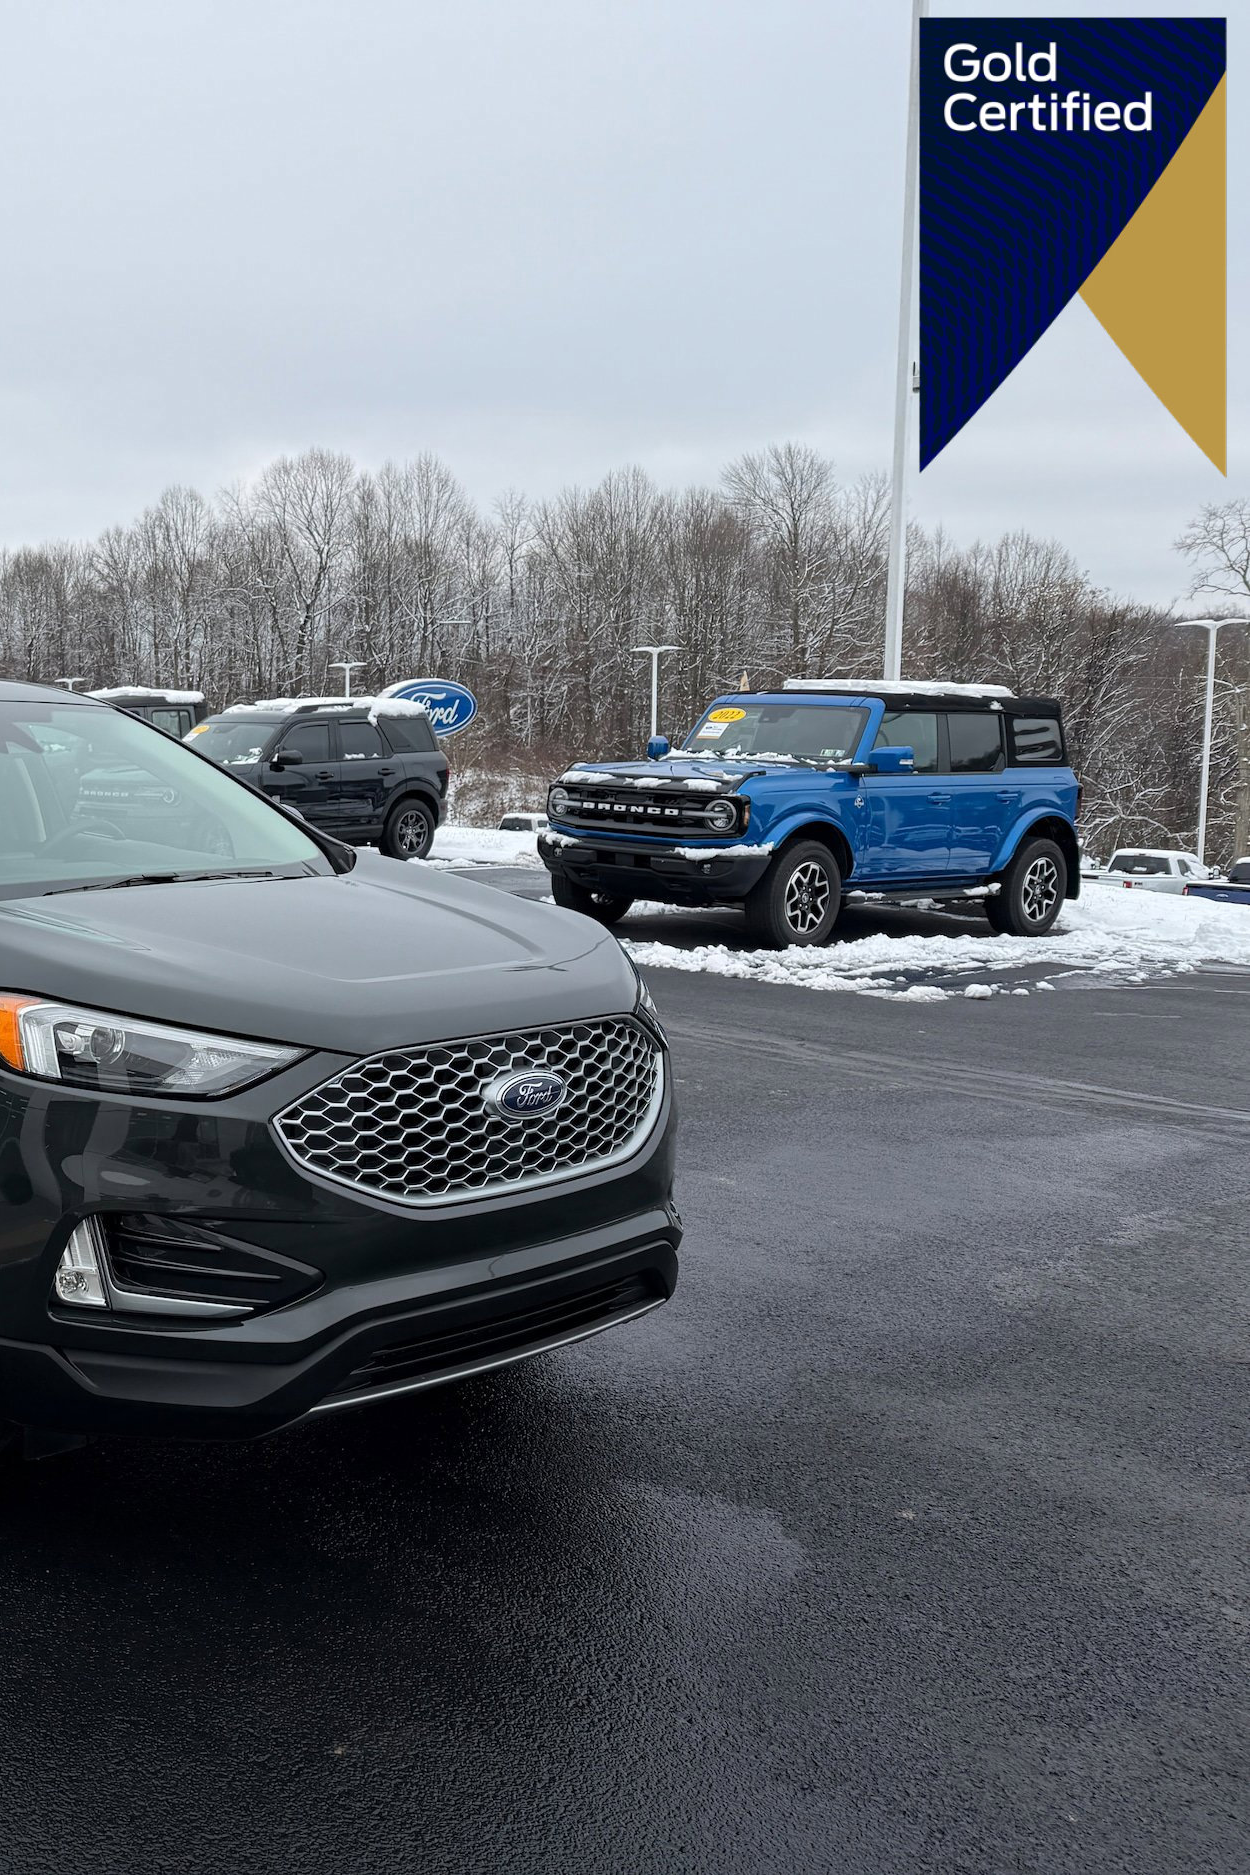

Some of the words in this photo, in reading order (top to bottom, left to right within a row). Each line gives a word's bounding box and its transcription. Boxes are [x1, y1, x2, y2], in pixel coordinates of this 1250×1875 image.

[410, 692, 460, 725] Frd
[582, 801, 680, 816] BRONCO
[516, 1081, 554, 1109] Ford
